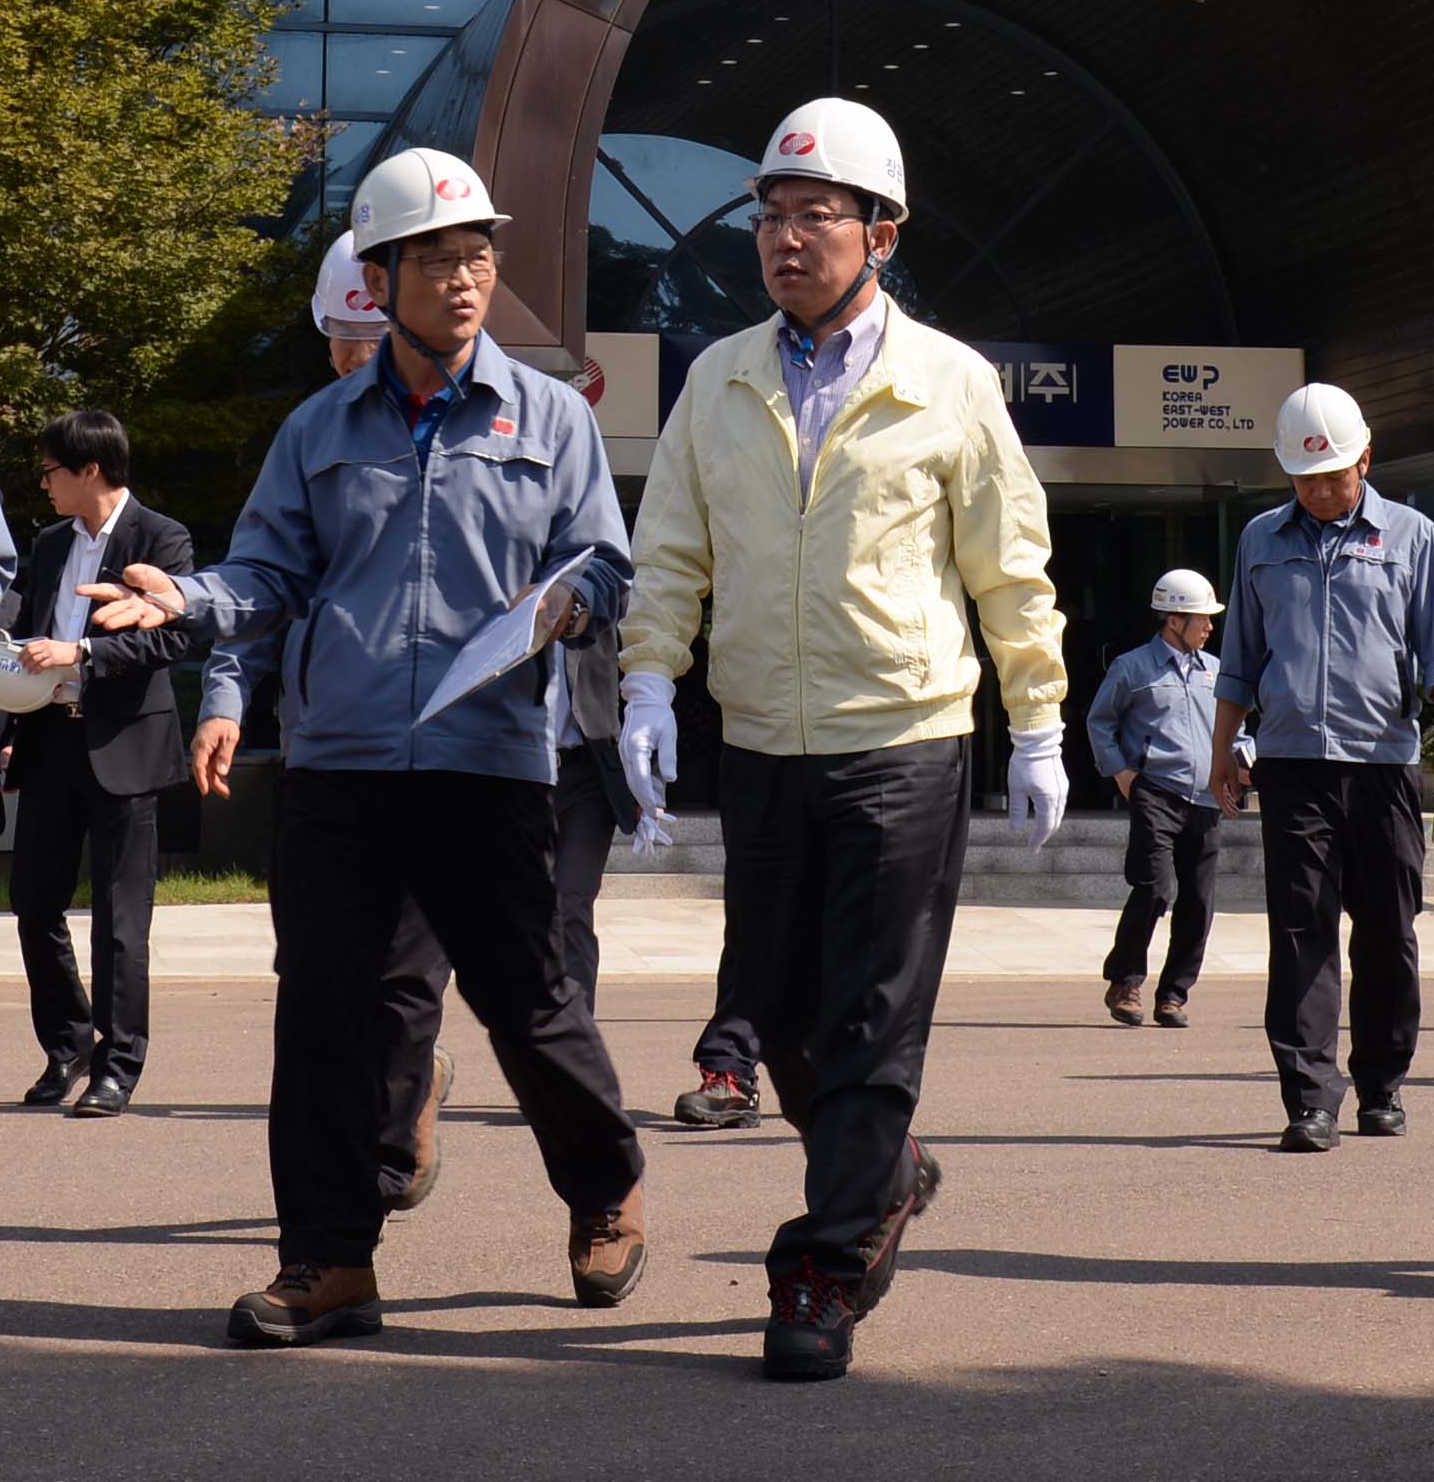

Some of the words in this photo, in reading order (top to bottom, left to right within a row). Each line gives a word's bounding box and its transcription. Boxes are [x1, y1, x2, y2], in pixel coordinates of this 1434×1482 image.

[1162, 364, 1220, 390] EWP
[1162, 390, 1203, 403] KOREA
[1162, 404, 1231, 417] EAST-WEST
[1162, 417, 1205, 432] POWER
[1233, 418, 1255, 430] LTD
